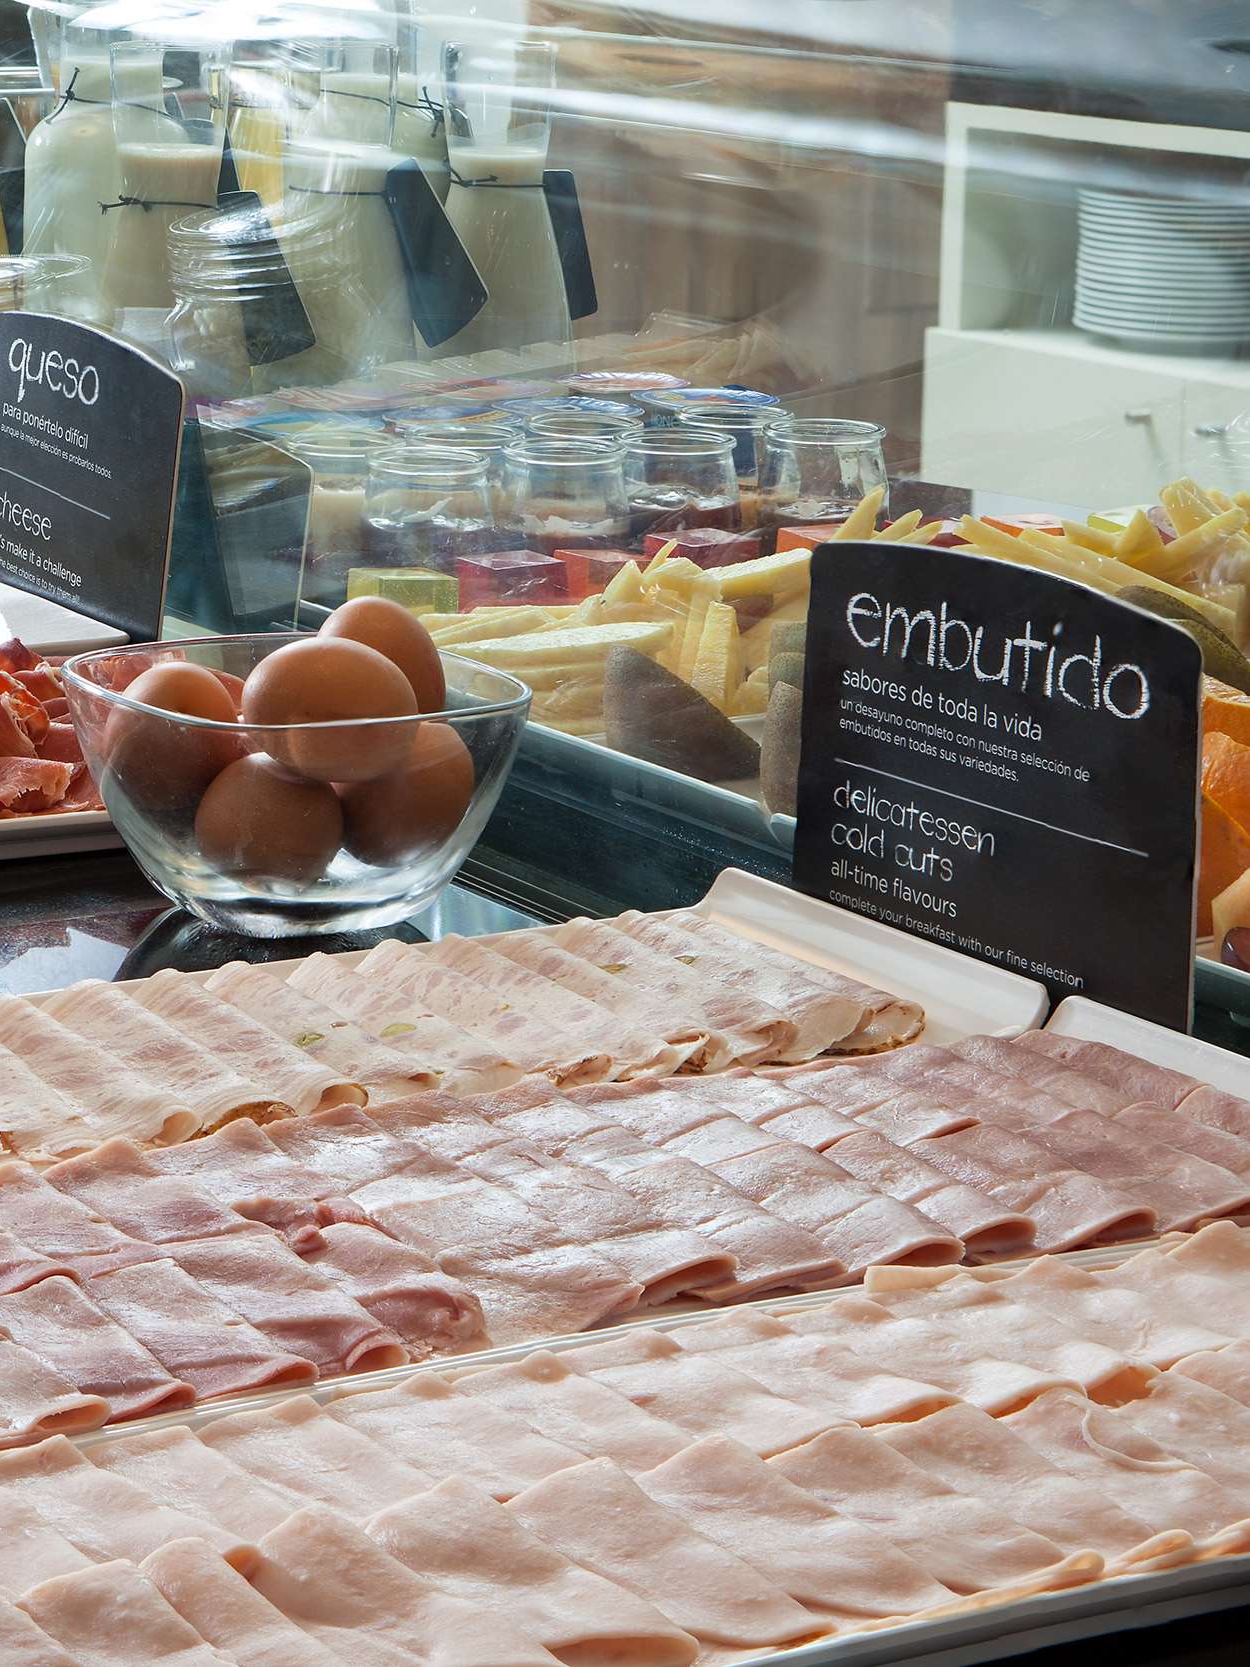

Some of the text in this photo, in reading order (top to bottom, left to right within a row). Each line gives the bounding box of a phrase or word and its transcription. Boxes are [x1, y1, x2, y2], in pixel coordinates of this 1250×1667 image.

[8, 338, 99, 405] queso
[0, 423, 20, 438] aunque
[19, 430, 25, 440] la
[24, 434, 40, 447] mejor
[61, 451, 68, 460] es
[68, 454, 94, 471] probarlos
[2, 402, 89, 450] para ponértelo difícil
[6, 541, 28, 560] make
[29, 548, 36, 565] it
[36, 555, 41, 567] a
[42, 558, 82, 587] challenge
[6, 561, 18, 575] best
[18, 567, 36, 583] choice
[36, 577, 41, 586] is
[41, 579, 48, 589] to
[846, 592, 1150, 720] embutido
[842, 668, 1042, 741] sabores de toda la vida
[839, 718, 1019, 782] embutidos en todas sus variedades.
[840, 699, 1090, 782] un desayuno completo con nuestra selección de
[833, 779, 995, 857] delicatessen
[831, 823, 953, 882] cold cuts
[830, 859, 957, 918] all-time flavours
[829, 890, 1084, 989] complete your breakfast with our fine selection
